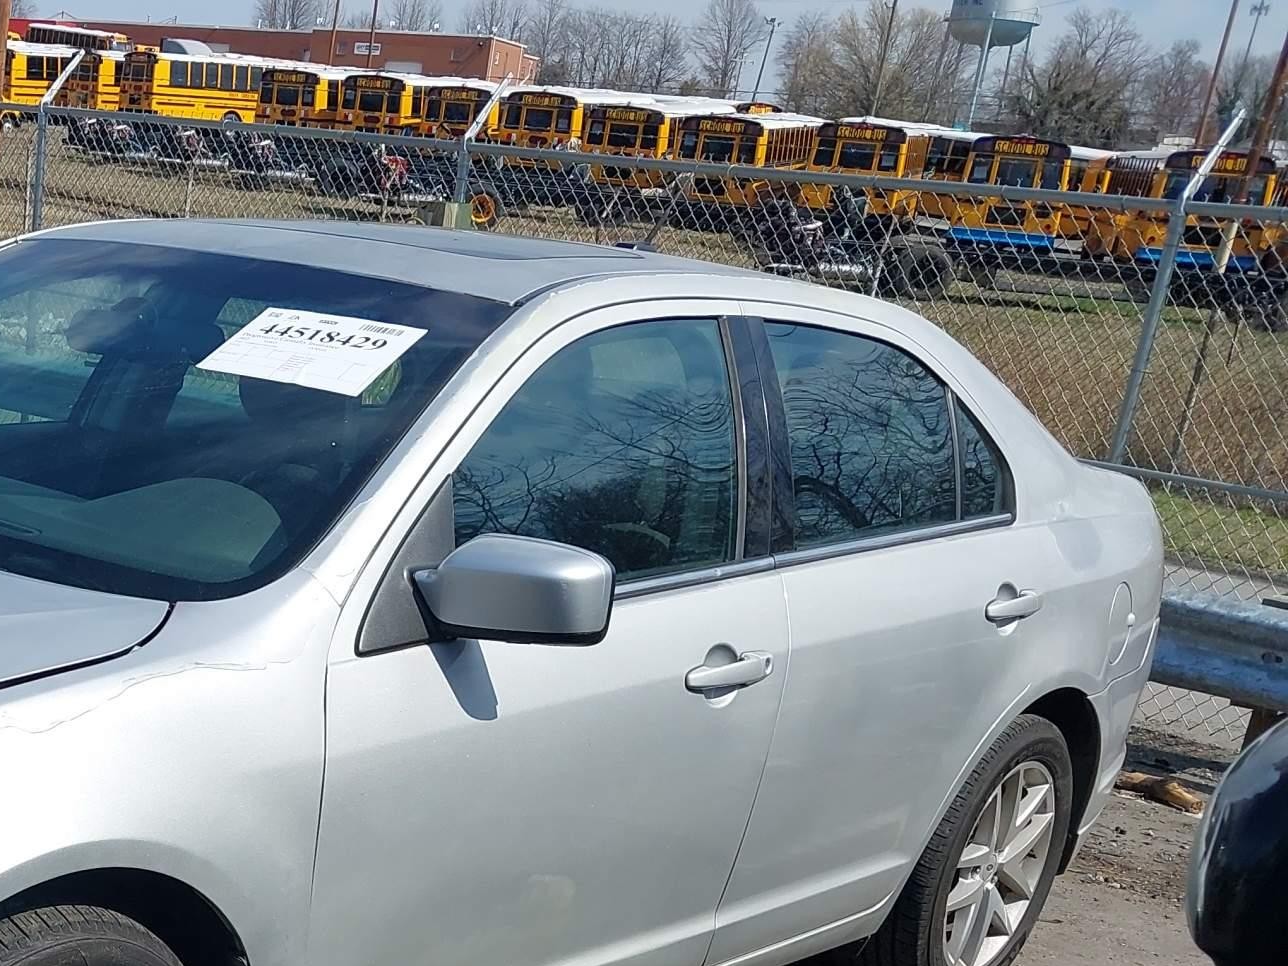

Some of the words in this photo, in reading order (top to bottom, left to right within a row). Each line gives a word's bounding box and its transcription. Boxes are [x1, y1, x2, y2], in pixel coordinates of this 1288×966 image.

[607, 109, 634, 120] SCHOOL
[635, 110, 648, 121] BUS
[700, 120, 730, 132] SCHOOL
[731, 122, 744, 133] BUS
[838, 126, 872, 140] SCHOOL
[873, 129, 887, 140] BUS
[995, 140, 1032, 154] SCHOOL
[1033, 144, 1049, 156] BUS
[259, 323, 388, 351] 44518429
